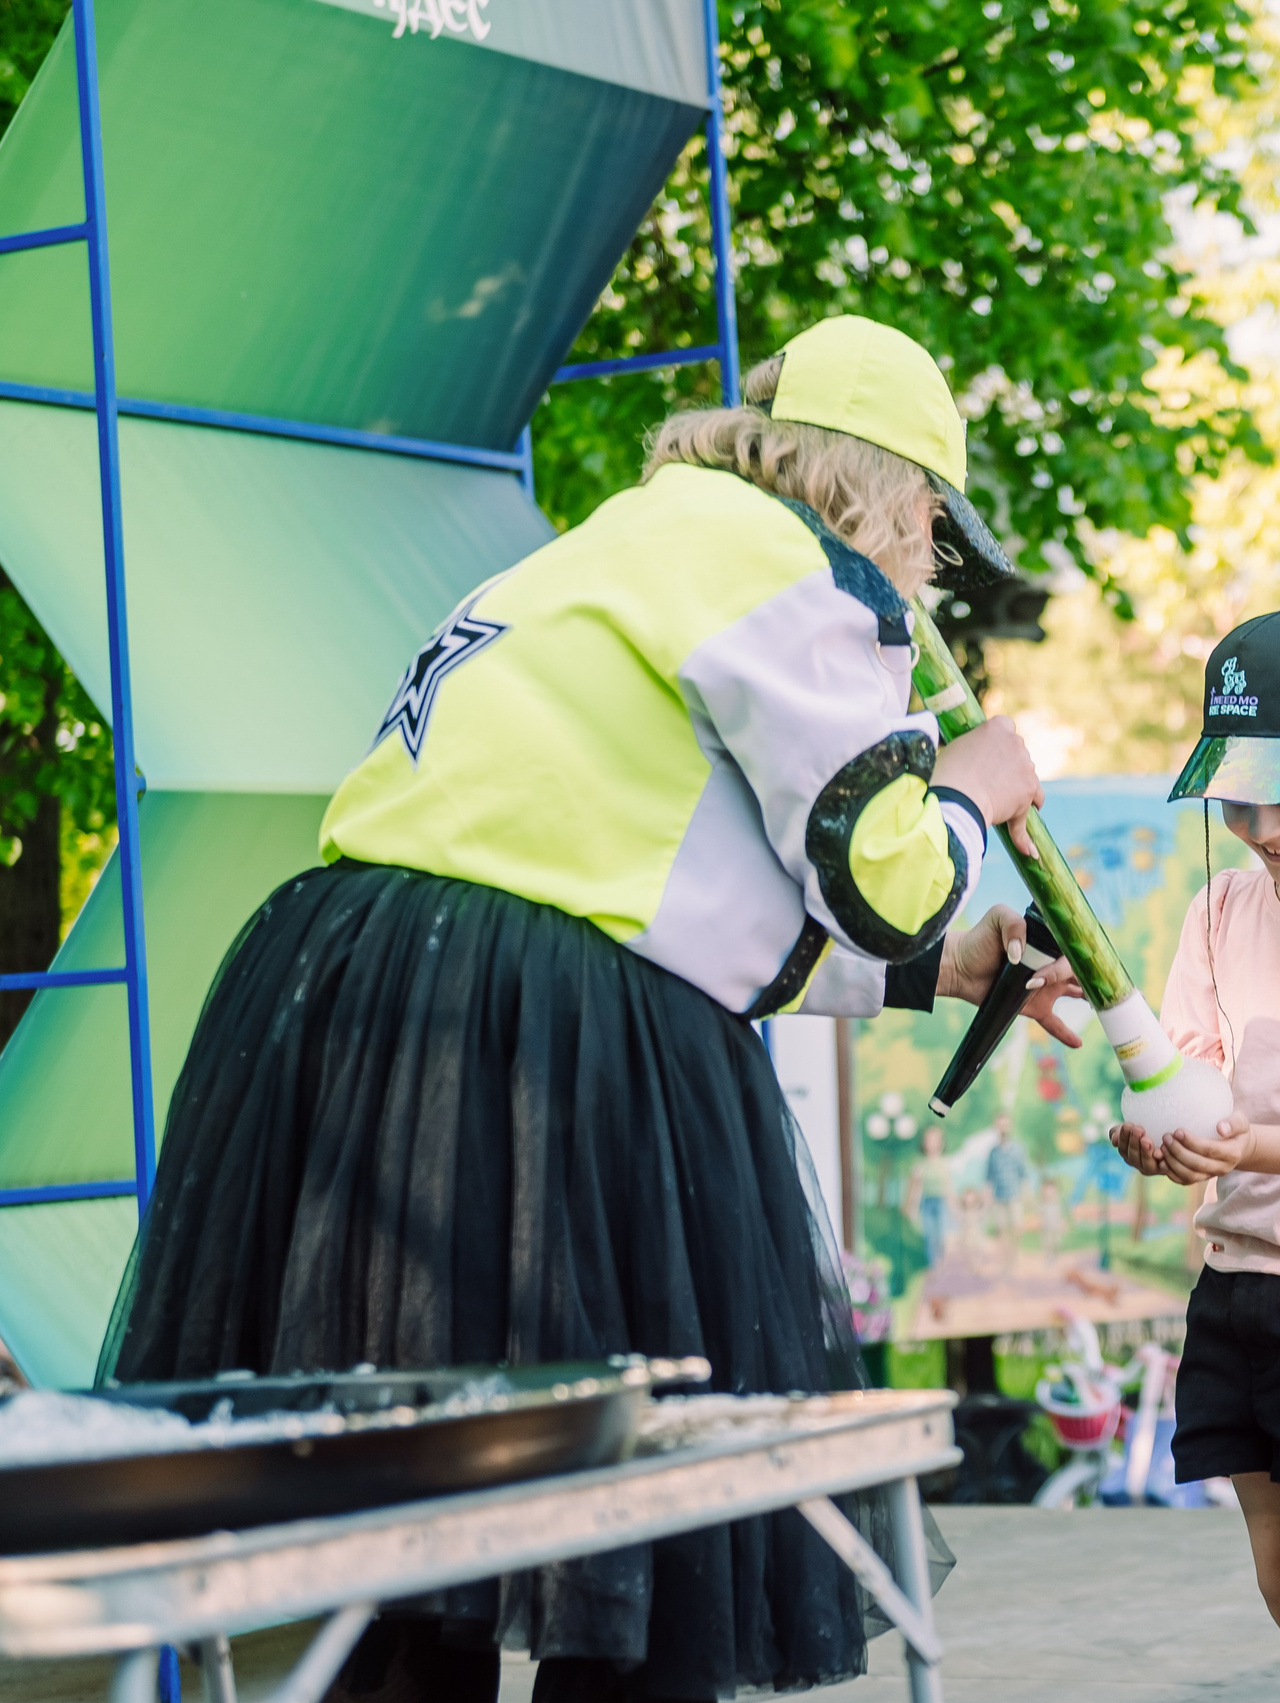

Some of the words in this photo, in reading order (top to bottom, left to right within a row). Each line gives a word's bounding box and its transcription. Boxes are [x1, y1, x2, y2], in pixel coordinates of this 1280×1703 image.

[1214, 695, 1237, 704] NEED
[1239, 695, 1258, 705] MO
[1209, 705, 1219, 716] RE
[1220, 704, 1257, 716] SPACE
